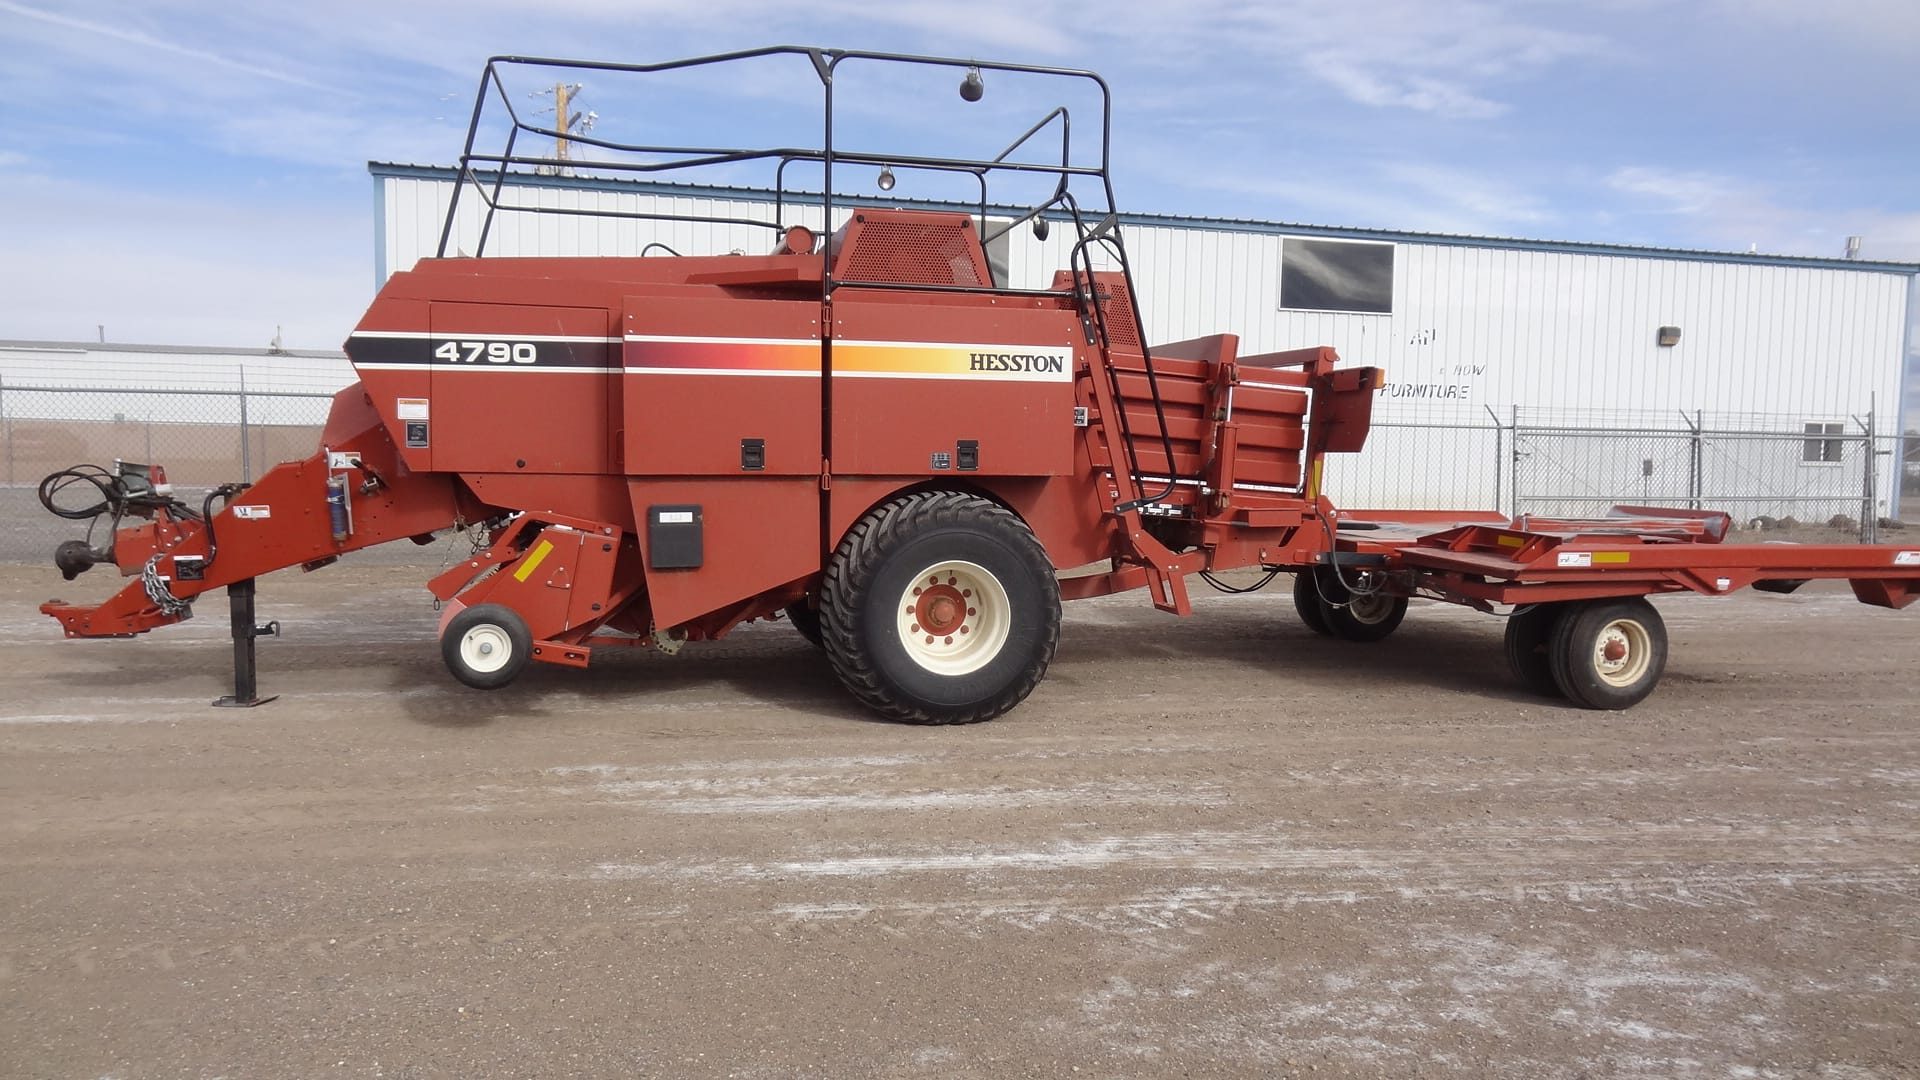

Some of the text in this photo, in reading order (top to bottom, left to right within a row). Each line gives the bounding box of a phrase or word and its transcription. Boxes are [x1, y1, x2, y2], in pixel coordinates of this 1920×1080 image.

[435, 341, 537, 364] 4790
[969, 353, 1064, 373] HESSTON
[1380, 383, 1470, 399] FURNITURE
